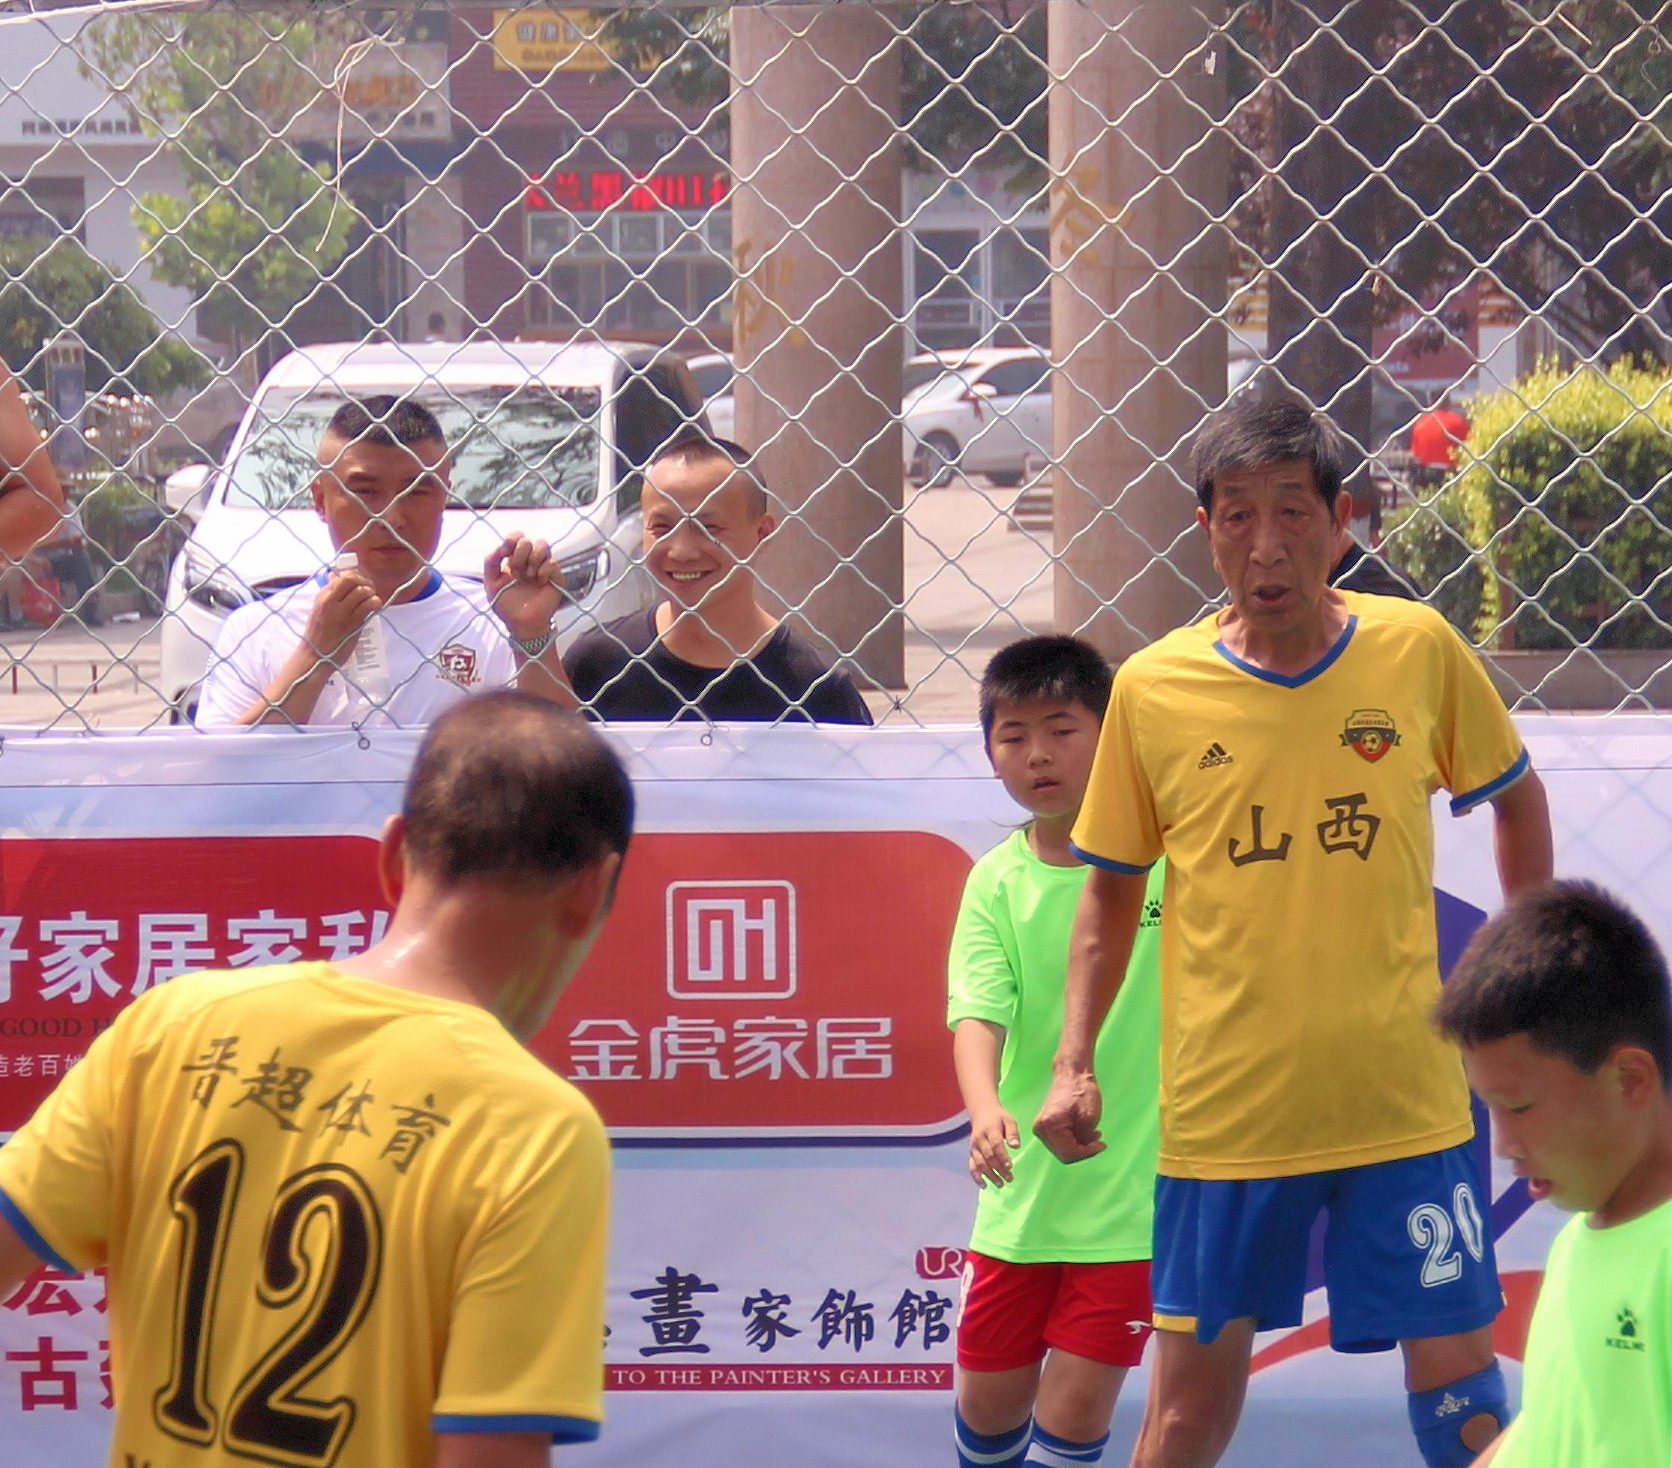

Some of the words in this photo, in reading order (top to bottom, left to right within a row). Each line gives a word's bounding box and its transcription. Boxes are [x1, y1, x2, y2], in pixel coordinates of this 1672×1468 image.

[1197, 754, 1234, 770] adidas
[1229, 792, 1381, 867] 山西
[0, 1017, 84, 1039] GOOD
[567, 1015, 893, 1080] 金虎家居
[1407, 1182, 1483, 1288] 20
[603, 1266, 953, 1357] 畫家飾館
[612, 1369, 646, 1386] TO
[654, 1369, 703, 1386] THE
[710, 1369, 831, 1386] PAINTER'S
[840, 1369, 946, 1386] GALLERY
